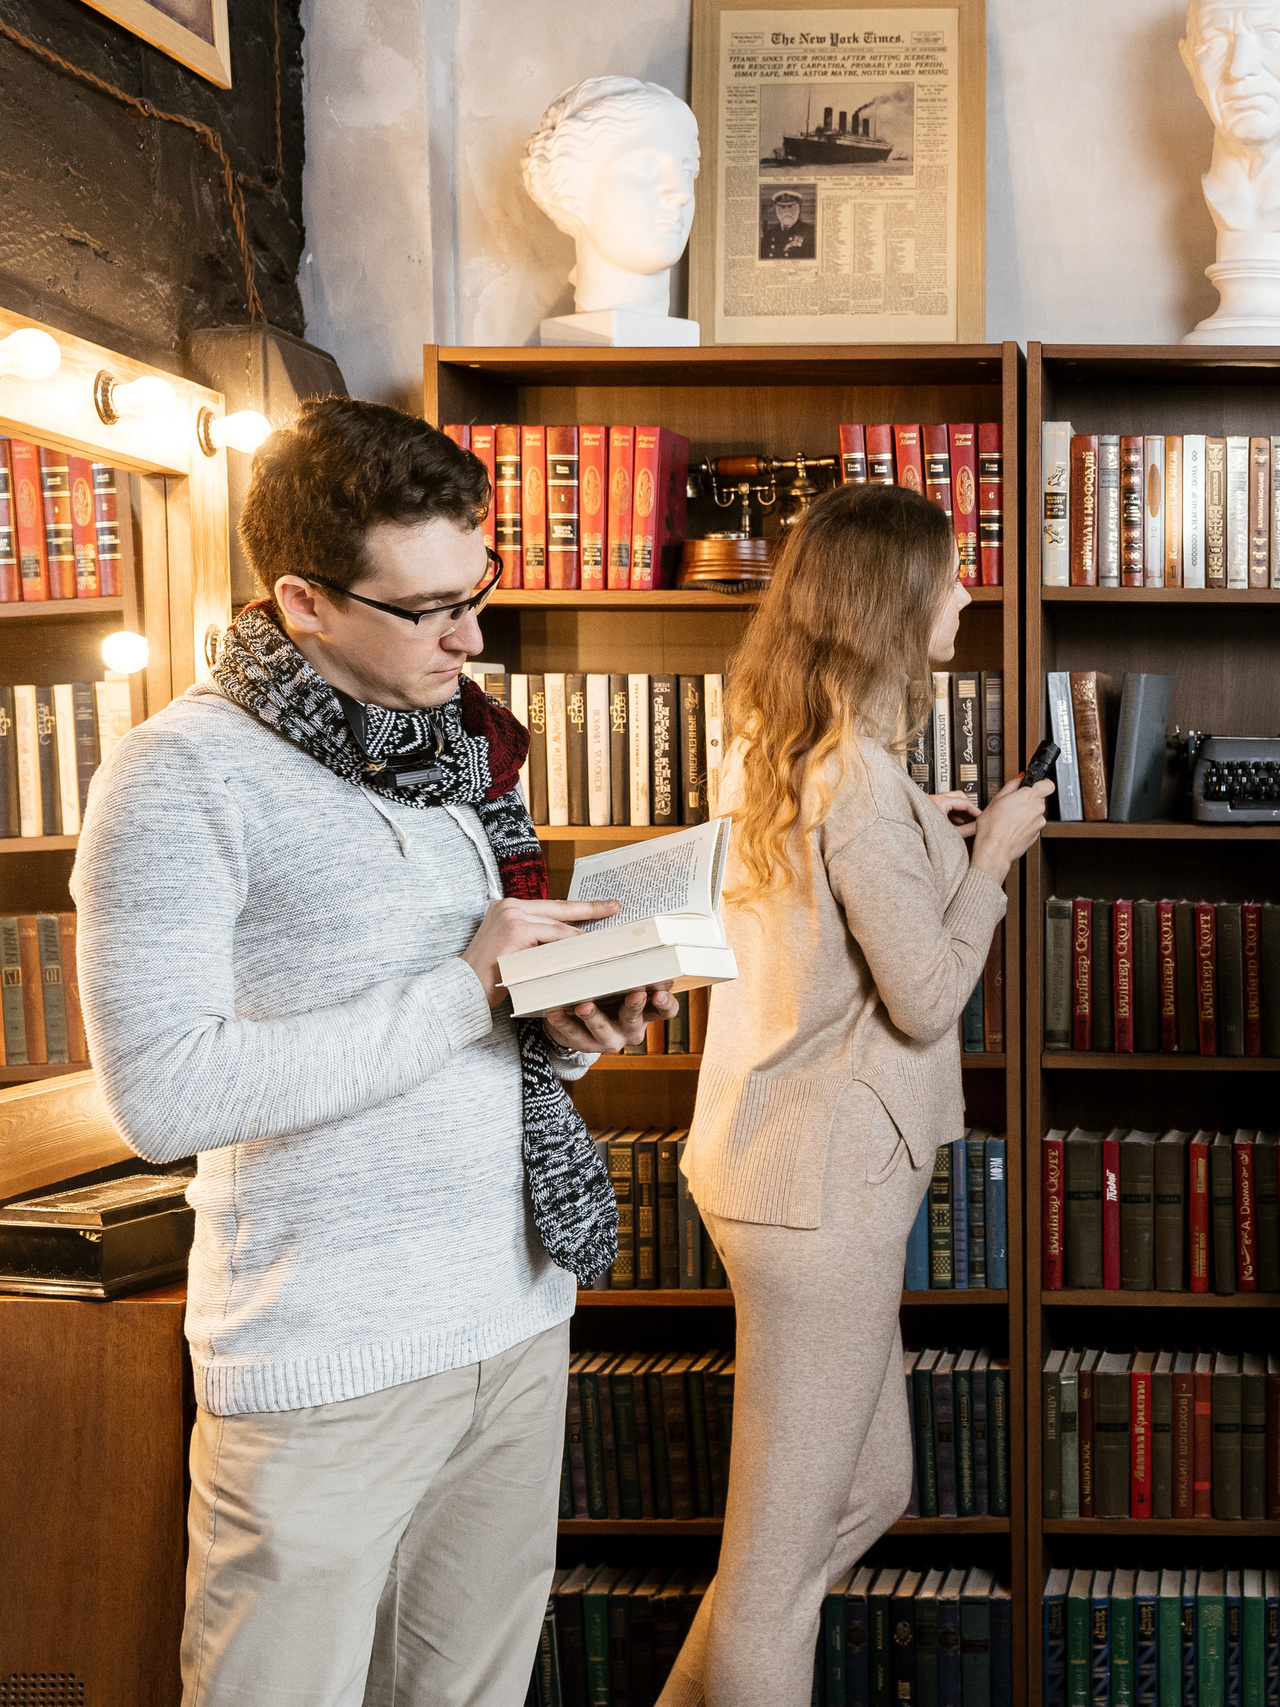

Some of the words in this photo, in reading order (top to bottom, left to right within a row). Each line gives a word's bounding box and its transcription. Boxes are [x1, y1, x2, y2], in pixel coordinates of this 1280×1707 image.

[729, 55, 759, 63] TITANIC
[841, 54, 866, 62] AFTER
[869, 54, 901, 62] HITTING
[770, 32, 796, 45] The
[799, 32, 826, 45] New
[829, 32, 859, 47] York
[863, 32, 905, 44] Times.
[734, 70, 758, 78] ISMAY
[802, 70, 829, 78] ASTOR
[889, 69, 915, 77] NAMES
[917, 69, 949, 77] MISSING
[851, 62, 892, 70] PROBABLY
[1168, 451, 1178, 506] СИМОНОВ
[1191, 465, 1199, 489] ДЮМА
[1084, 517, 1093, 526] И
[592, 709, 601, 744] ИВАНОВ
[594, 749, 603, 793] ВСЕВОЛОД
[688, 714, 698, 784] ОТВЕРЖЕННЫЕ
[1075, 908, 1089, 953] СКОТТ
[1116, 911, 1130, 957] СКОТТ
[1159, 910, 1173, 953] СКОТТ
[1199, 912, 1213, 958] СКОТТ
[1245, 912, 1258, 956] СКОТТ
[1077, 955, 1091, 1016] ВАЛЬТЕР
[1116, 957, 1130, 1020] ВАЛЬТЕР
[1161, 957, 1175, 1017] ВАЛЬТЕР
[1046, 1148, 1059, 1192] СКОТТ
[1048, 1195, 1061, 1256] ВАЛЬТЕР
[1240, 1217, 1251, 1230] А.
[1134, 1380, 1148, 1434] Кристи
[1179, 1398, 1188, 1455] ШОЛОХОВ
[1134, 1435, 1145, 1482] Агата
[1083, 1495, 1091, 1505] А.
[1179, 1459, 1188, 1507] МИХАИЛ
